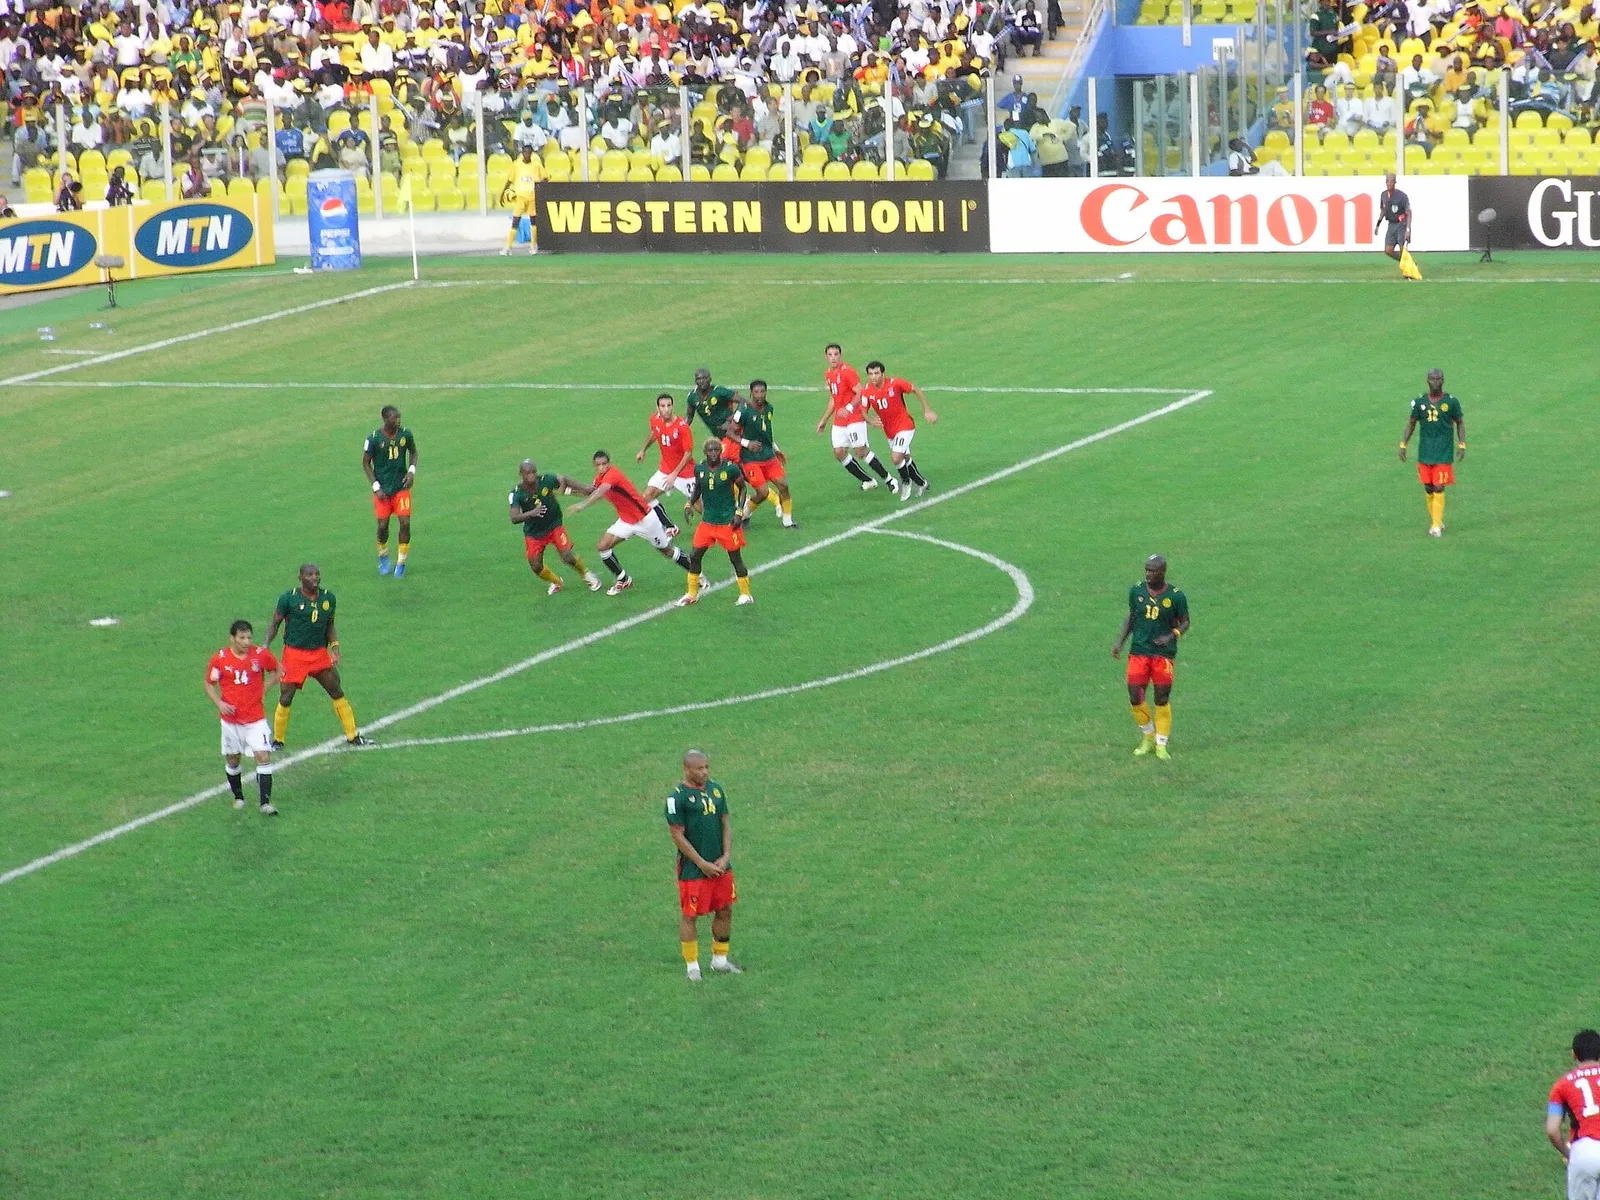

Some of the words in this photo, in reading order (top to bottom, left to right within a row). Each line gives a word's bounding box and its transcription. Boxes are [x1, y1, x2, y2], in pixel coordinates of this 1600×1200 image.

[546, 200, 763, 234] WESTERN
[1080, 184, 1374, 247] Canon
[157, 213, 232, 256] MTN
[0, 231, 75, 275] MTN
[877, 398, 888, 410] 10
[233, 669, 249, 685] 14
[701, 797, 717, 817] 14
